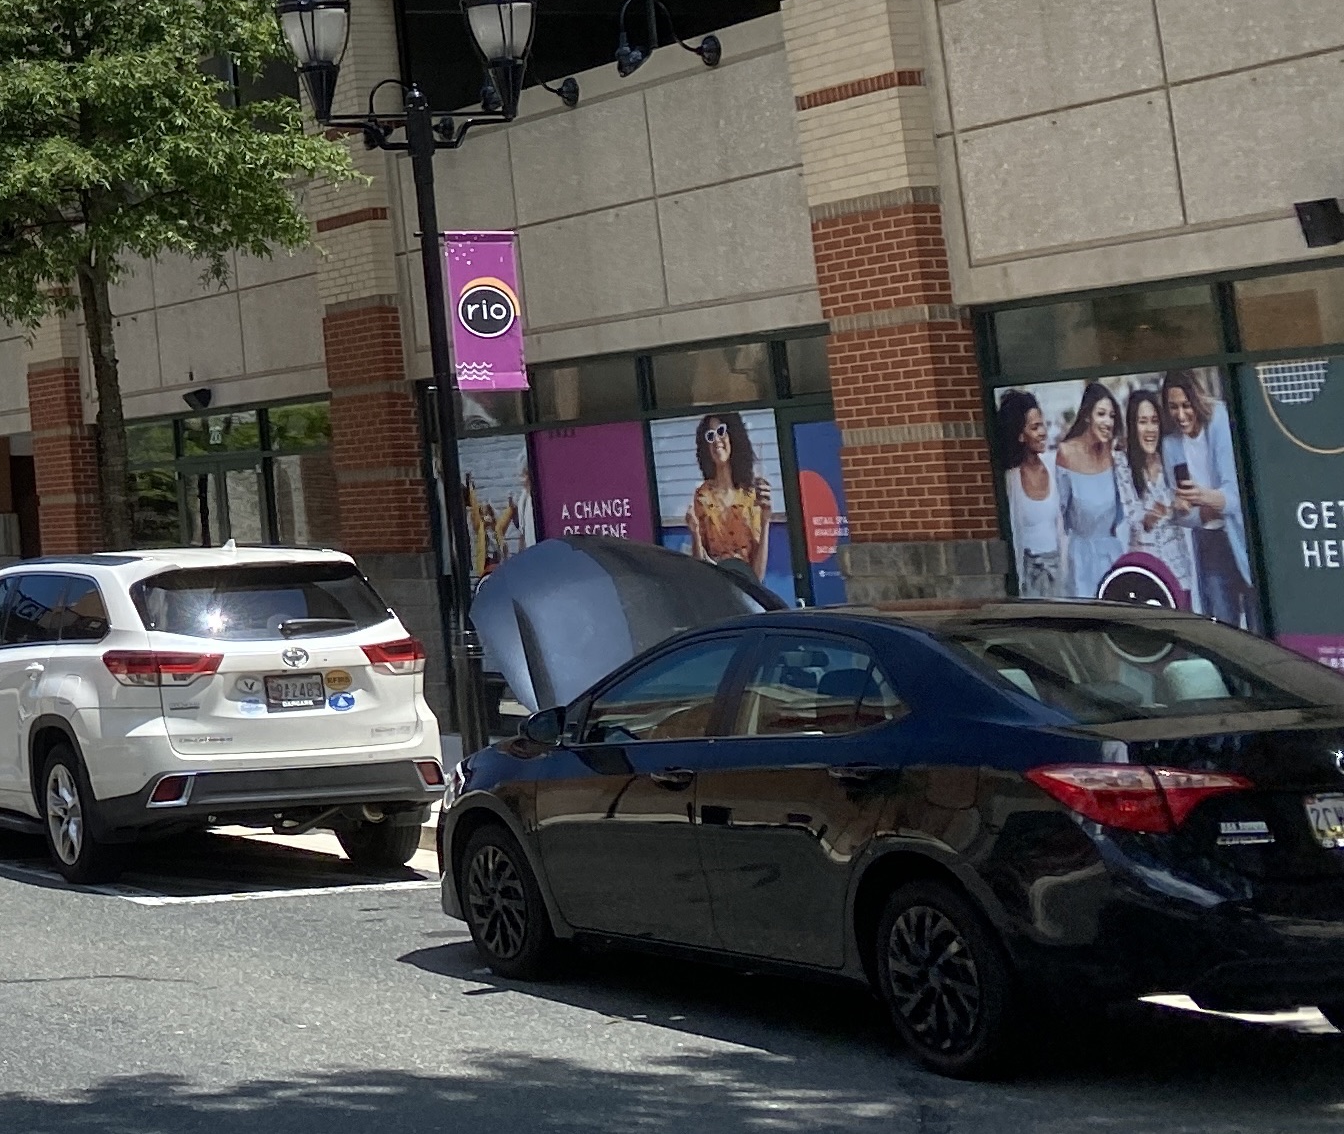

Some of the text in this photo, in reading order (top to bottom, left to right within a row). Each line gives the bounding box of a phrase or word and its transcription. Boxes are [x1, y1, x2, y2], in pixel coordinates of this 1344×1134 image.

[467, 299, 507, 320] rio
[561, 498, 632, 520] A CHANGE
[1301, 539, 1344, 568] HE
